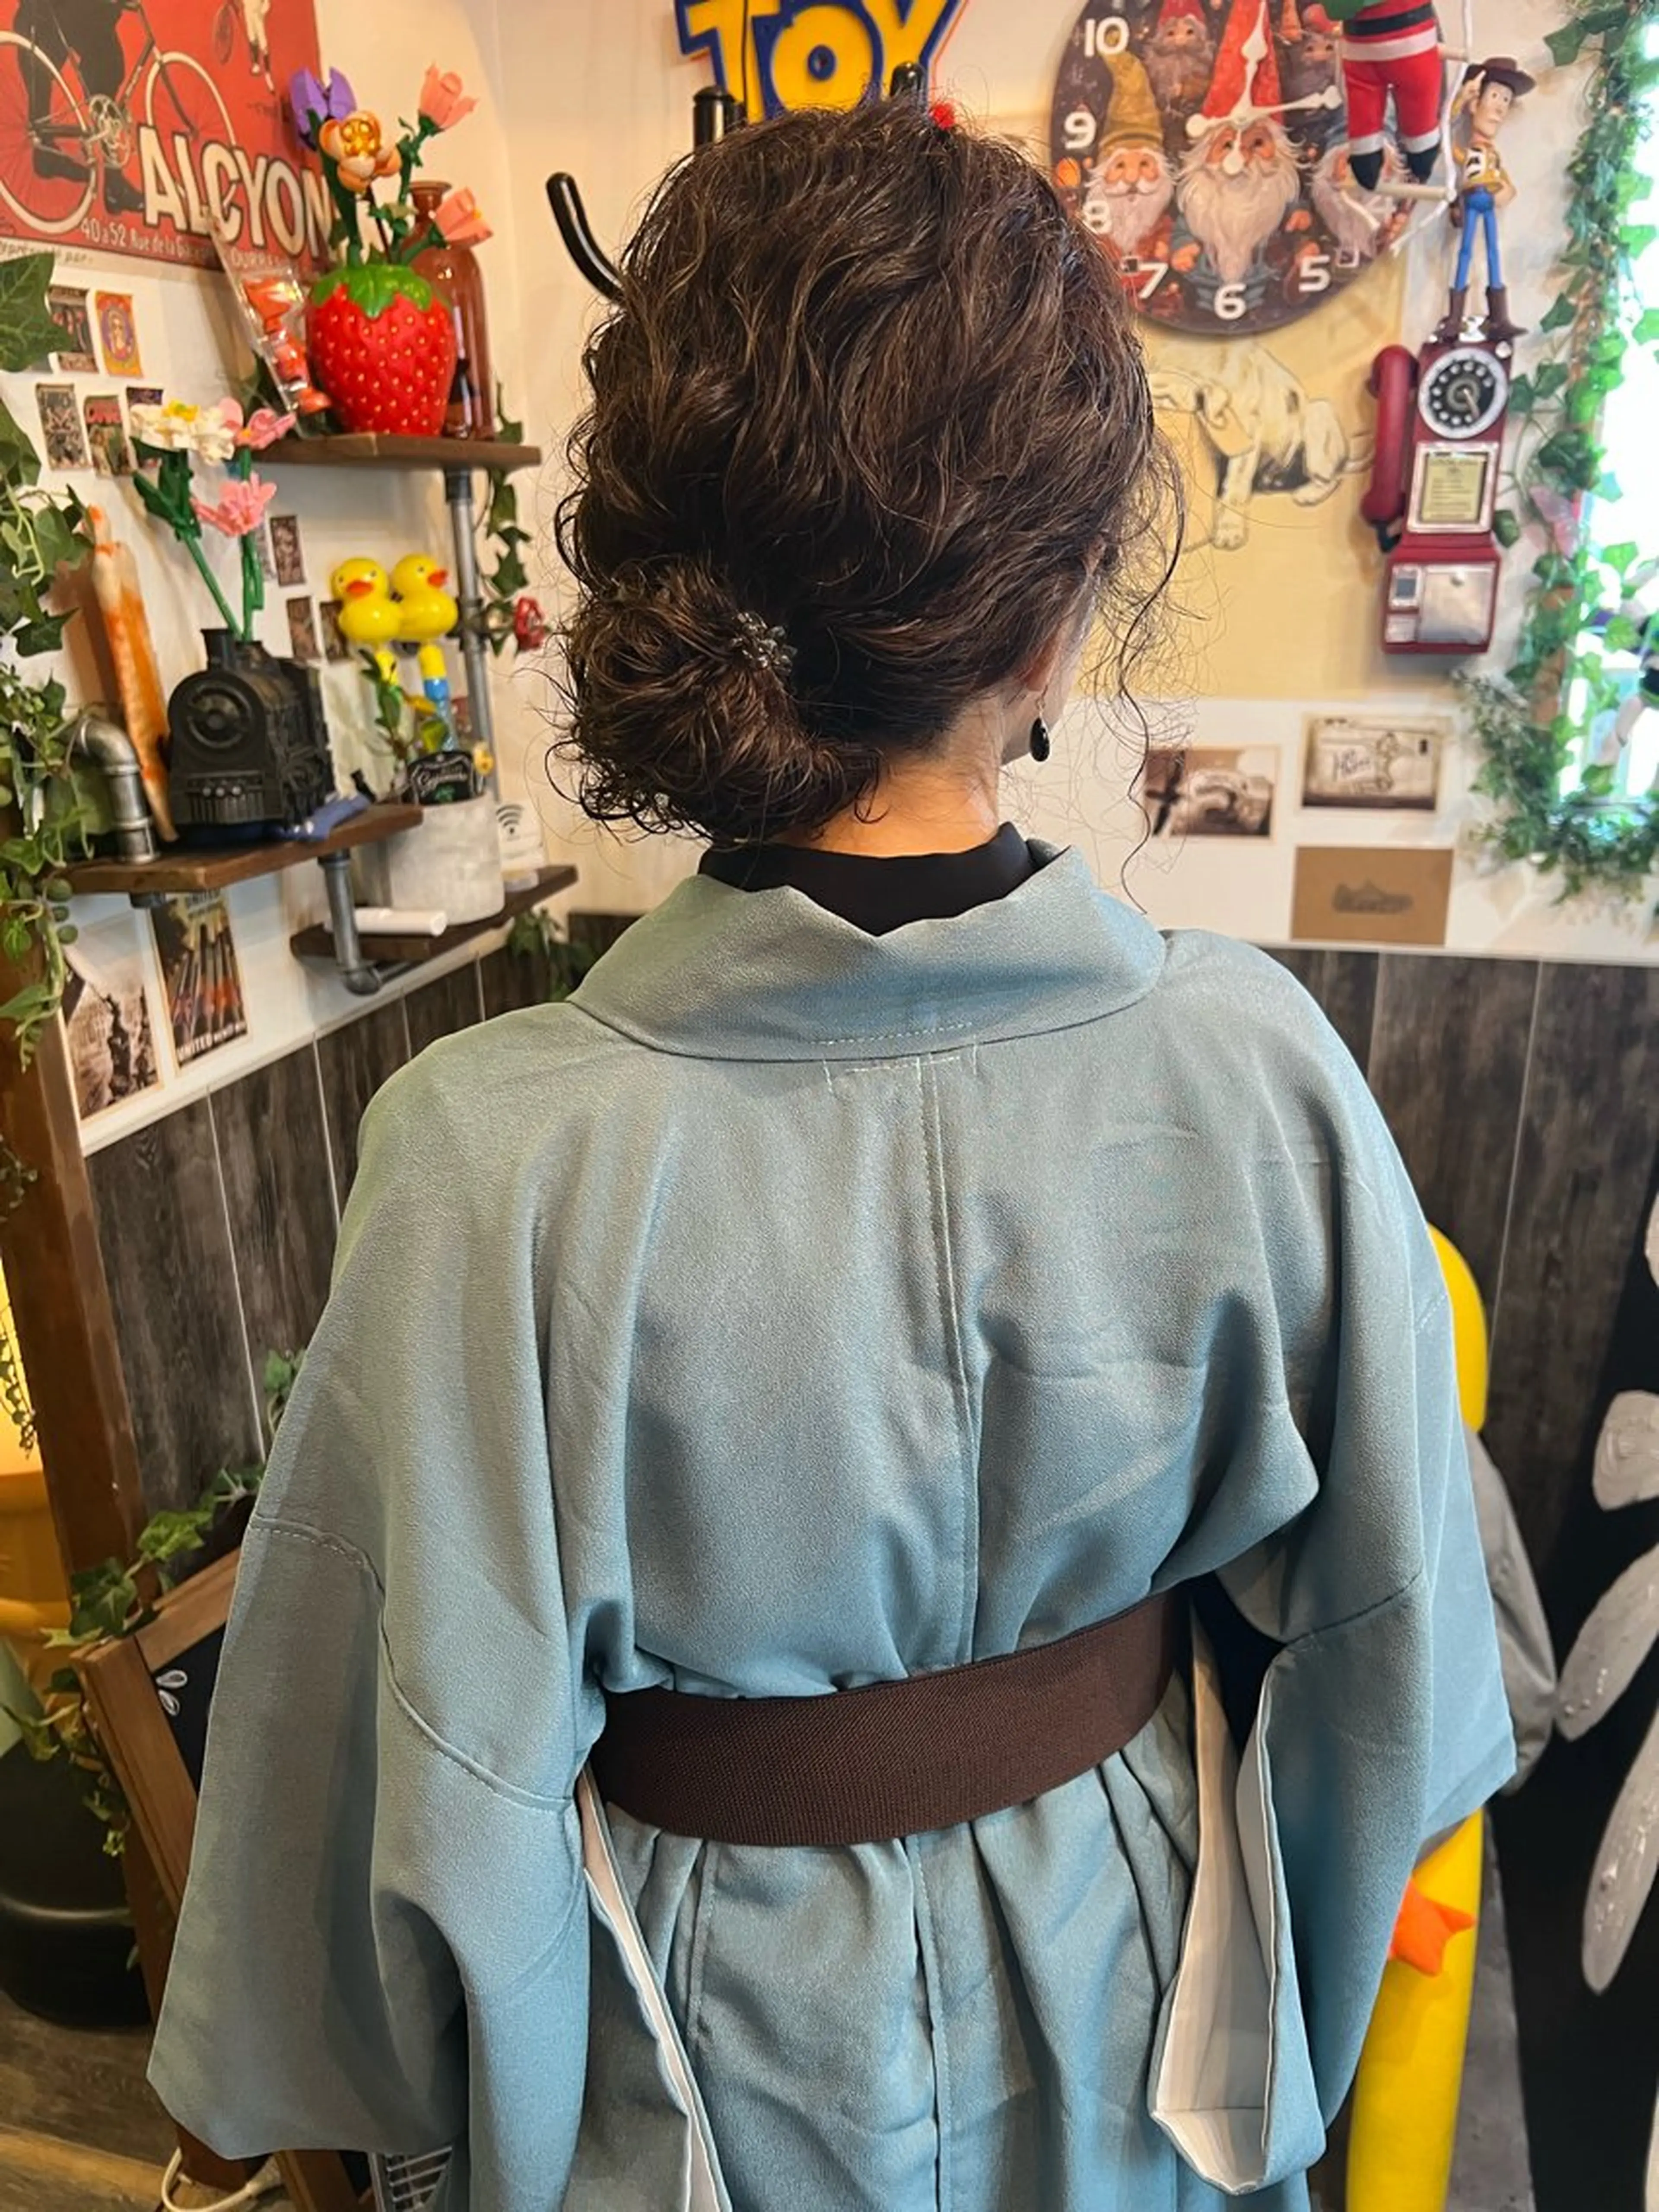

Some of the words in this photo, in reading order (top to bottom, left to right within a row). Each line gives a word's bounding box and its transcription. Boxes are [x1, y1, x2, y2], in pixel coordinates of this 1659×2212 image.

[1084, 16, 1129, 57] 10
[675, 0, 957, 124] TOY
[1064, 111, 1096, 149] 9
[139, 126, 333, 257] ALCYON
[1082, 200, 1112, 234] 8
[1137, 262, 1168, 299] 7
[1299, 255, 1331, 292] 5
[1214, 283, 1247, 320] 6
